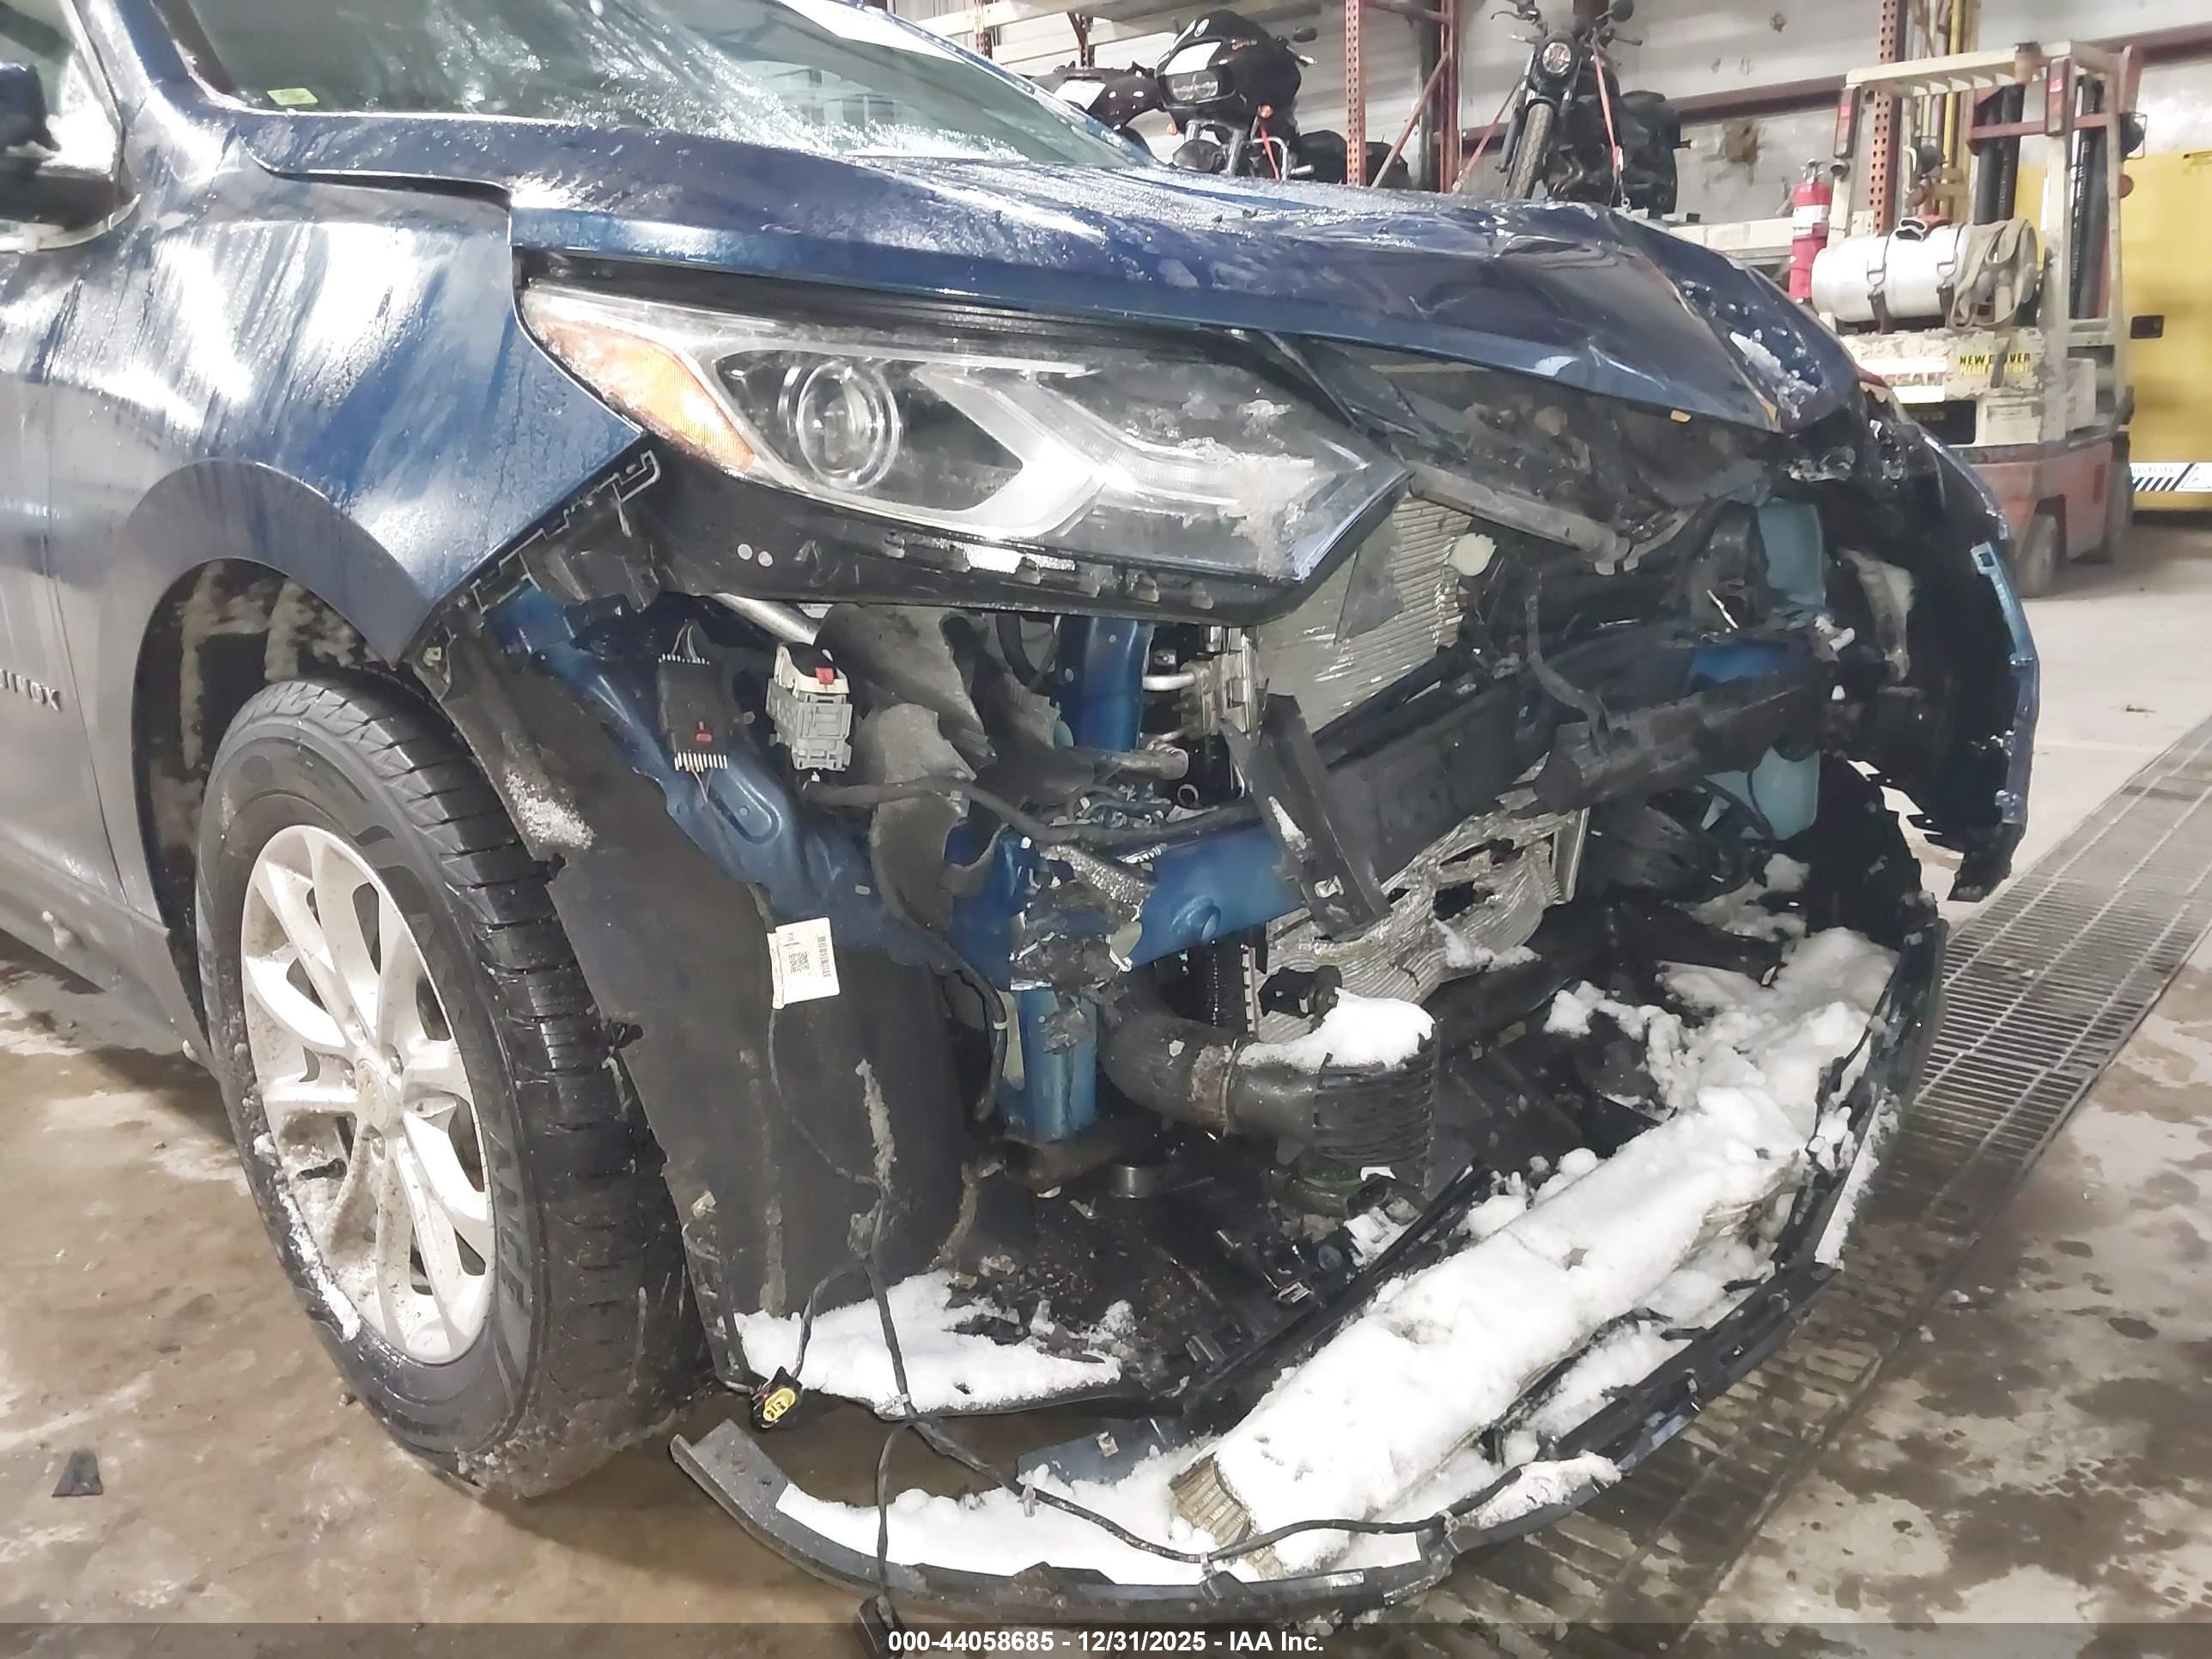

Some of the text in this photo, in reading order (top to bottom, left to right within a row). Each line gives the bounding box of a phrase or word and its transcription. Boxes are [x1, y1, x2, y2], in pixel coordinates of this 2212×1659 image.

[1959, 353, 2031, 365] NEW DVER
[0, 668, 63, 712] INOX
